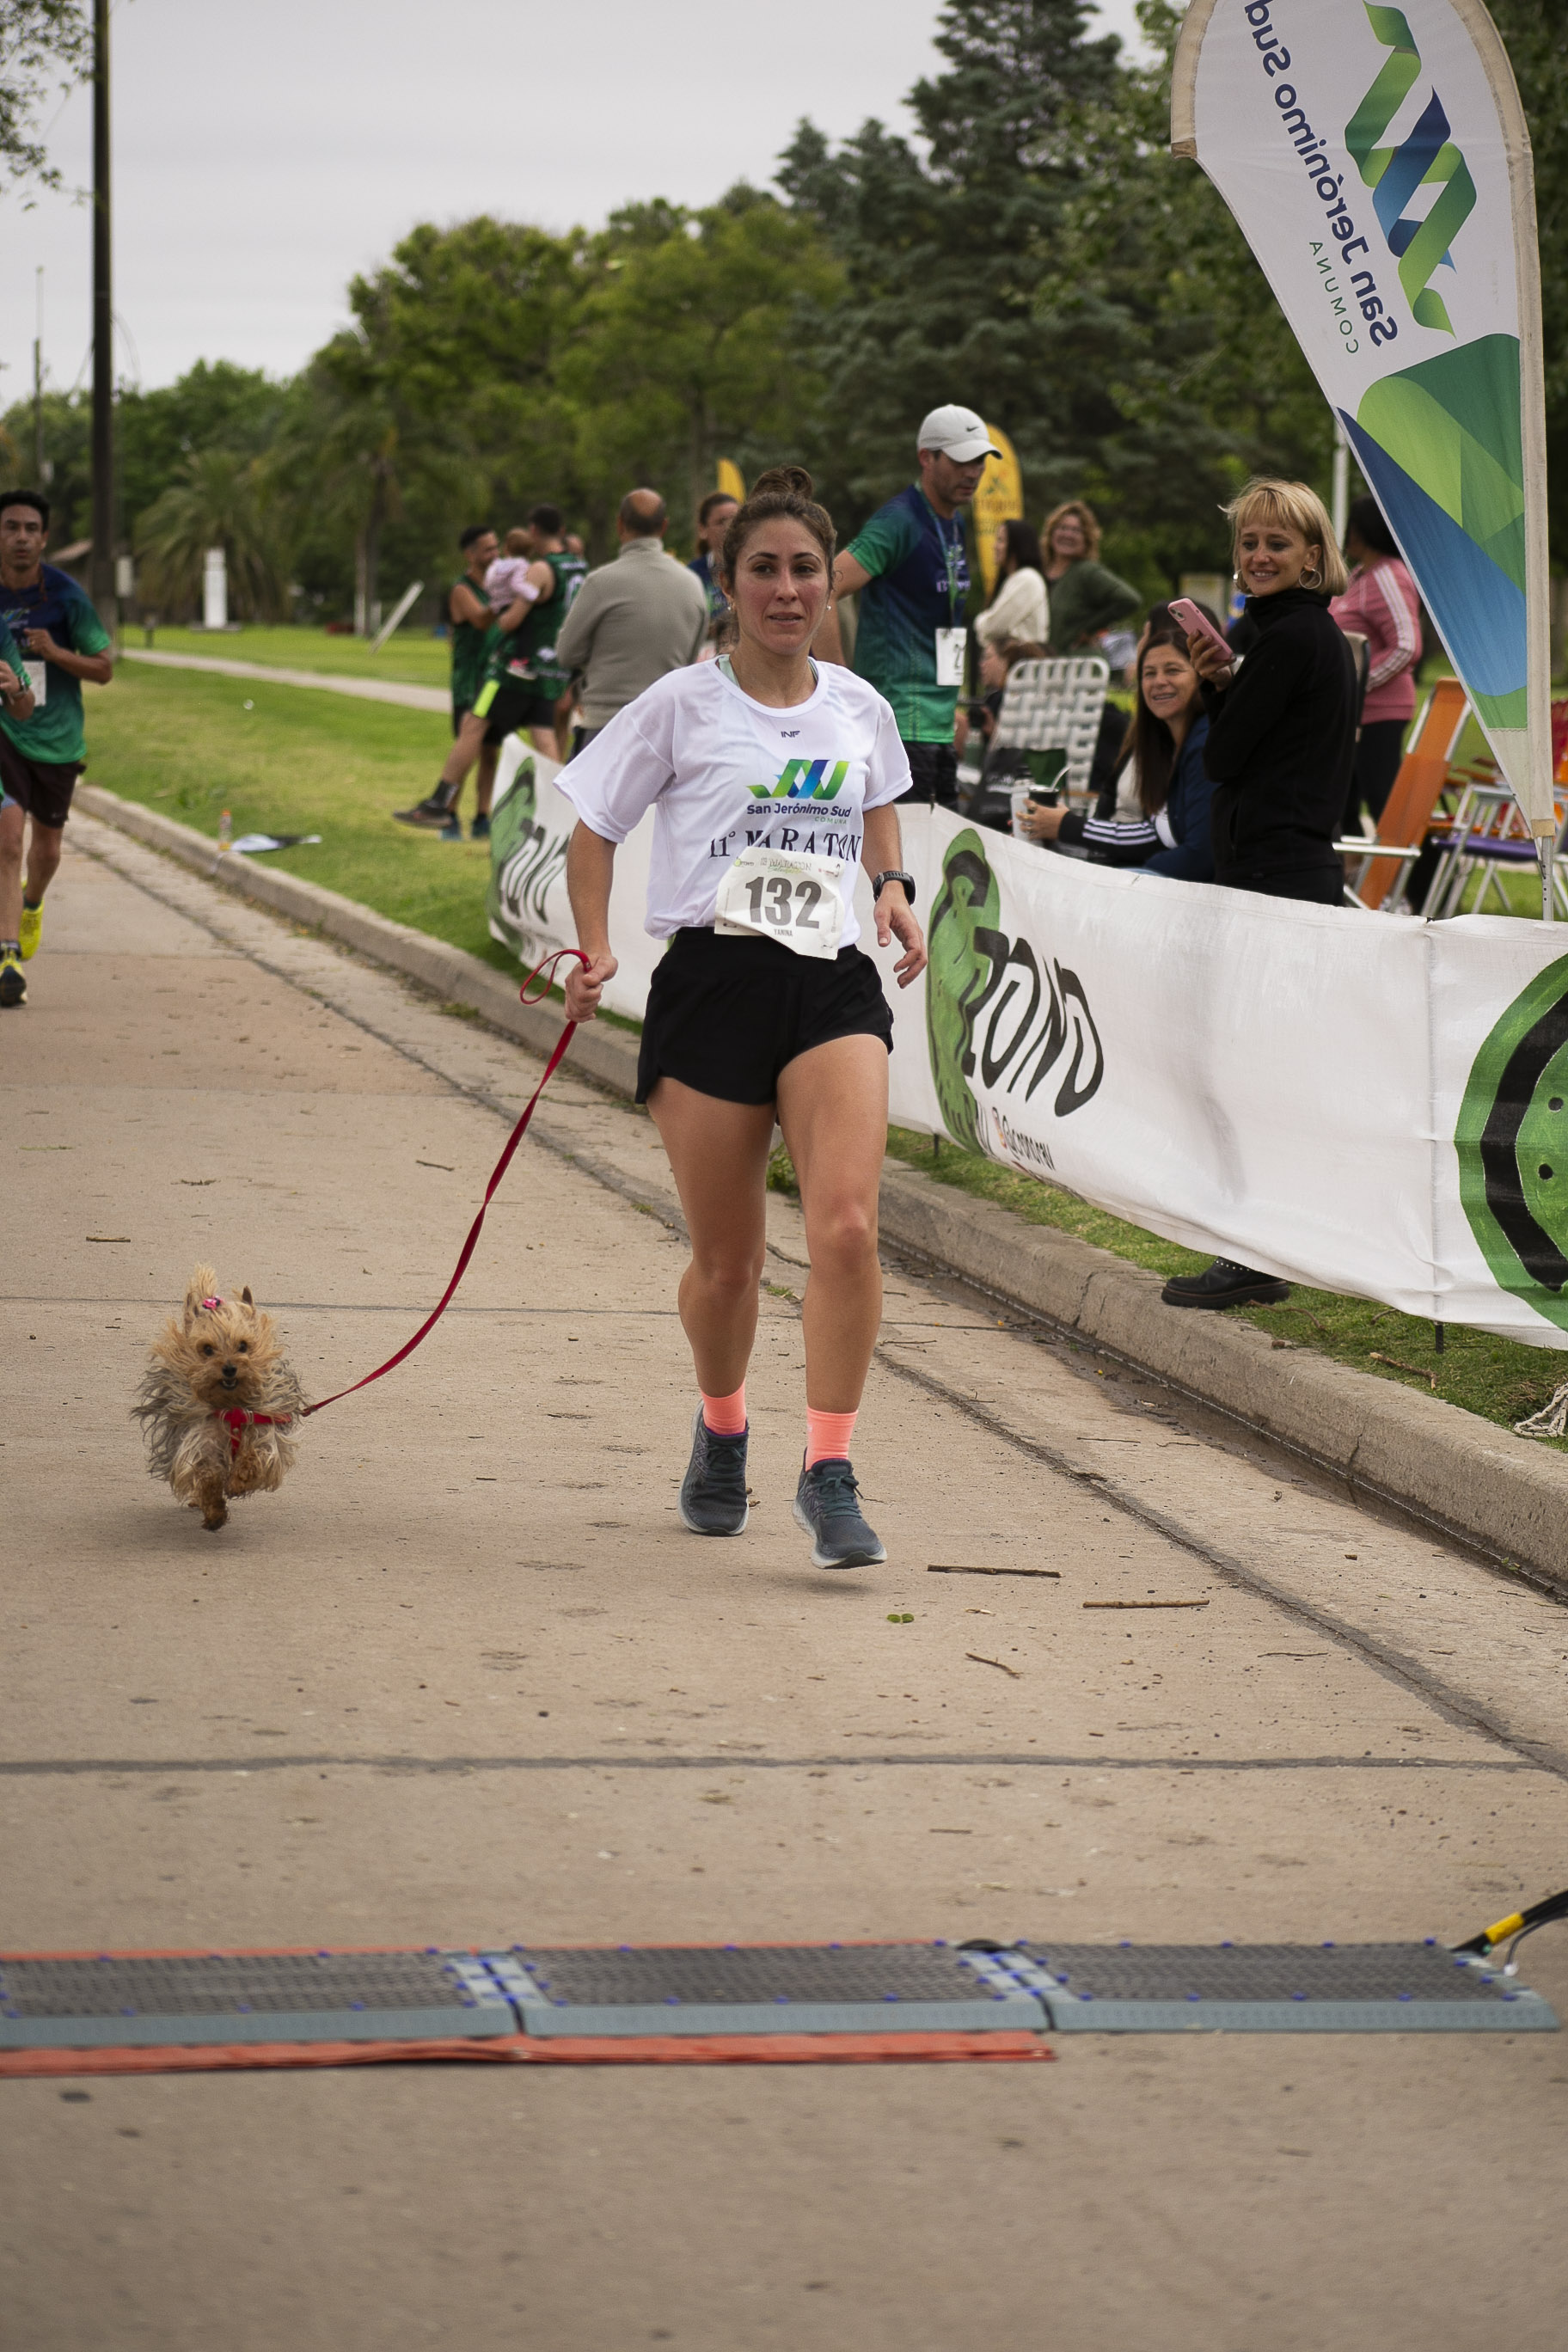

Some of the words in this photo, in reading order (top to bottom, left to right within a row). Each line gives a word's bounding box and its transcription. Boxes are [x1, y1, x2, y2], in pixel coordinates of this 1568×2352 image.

[746, 803, 771, 815] San
[774, 802, 830, 816] Jerónimo
[830, 805, 852, 818] Sud
[814, 817, 848, 825] COMUNA
[744, 876, 822, 929] 132
[774, 928, 793, 937] YANINA
